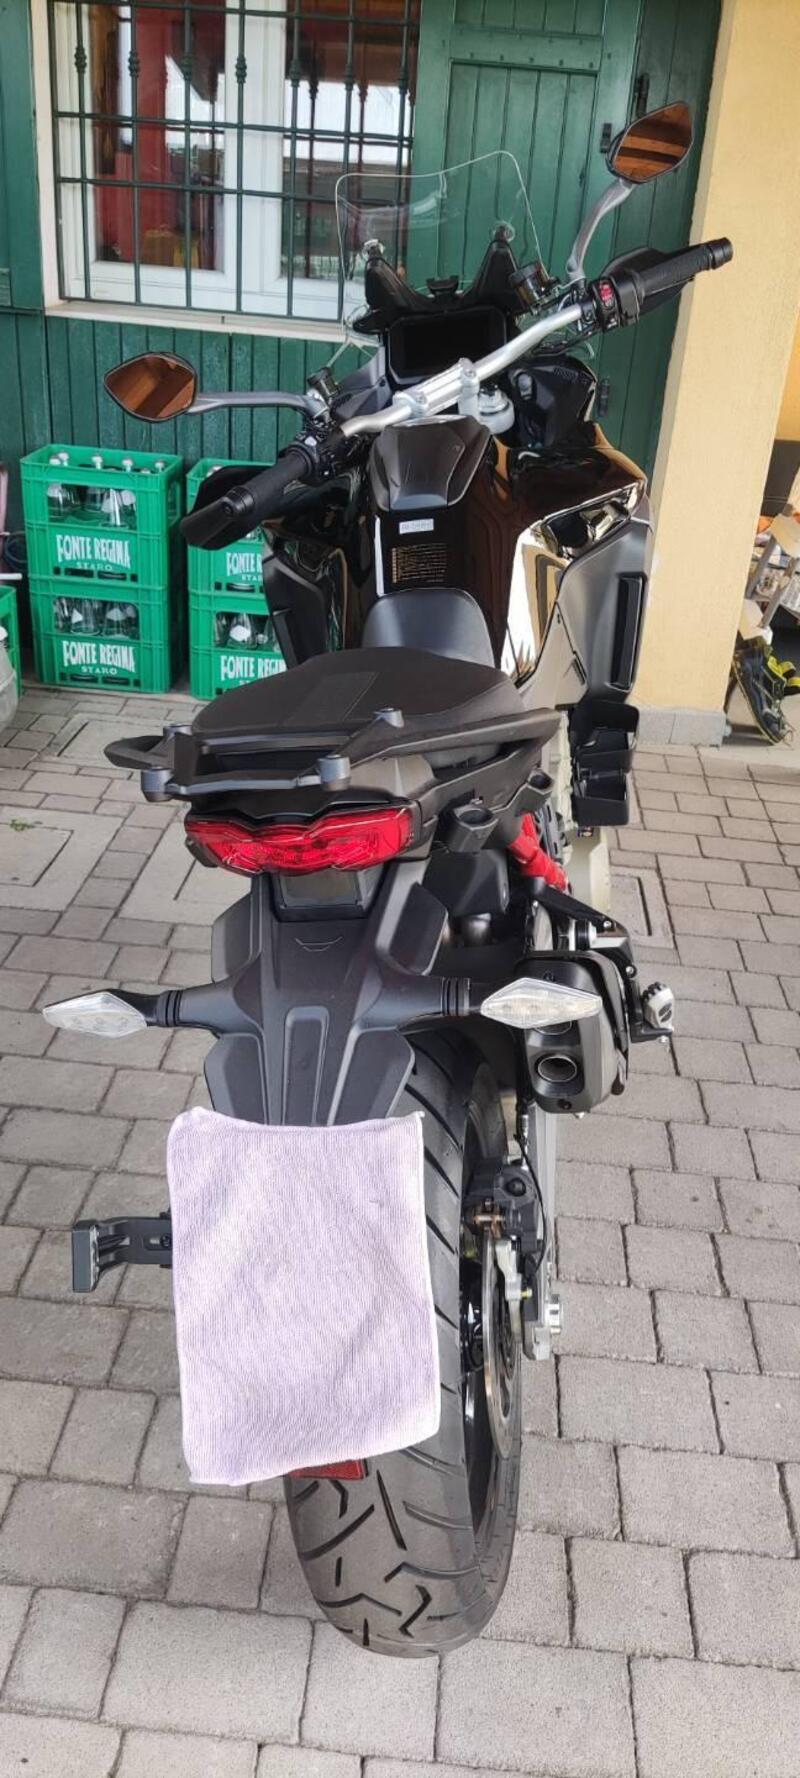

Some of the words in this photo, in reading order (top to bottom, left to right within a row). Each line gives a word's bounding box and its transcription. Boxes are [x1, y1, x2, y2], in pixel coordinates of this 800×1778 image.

[56, 534, 92, 563] FONTE
[94, 537, 131, 569] REGINA
[226, 552, 255, 577] FONTE
[241, 574, 263, 582] STAR
[62, 640, 97, 667] FONTE
[99, 643, 136, 673] REGINA
[220, 655, 255, 682] FONTE
[257, 658, 288, 680] REGIN
[81, 665, 118, 675] STARO
